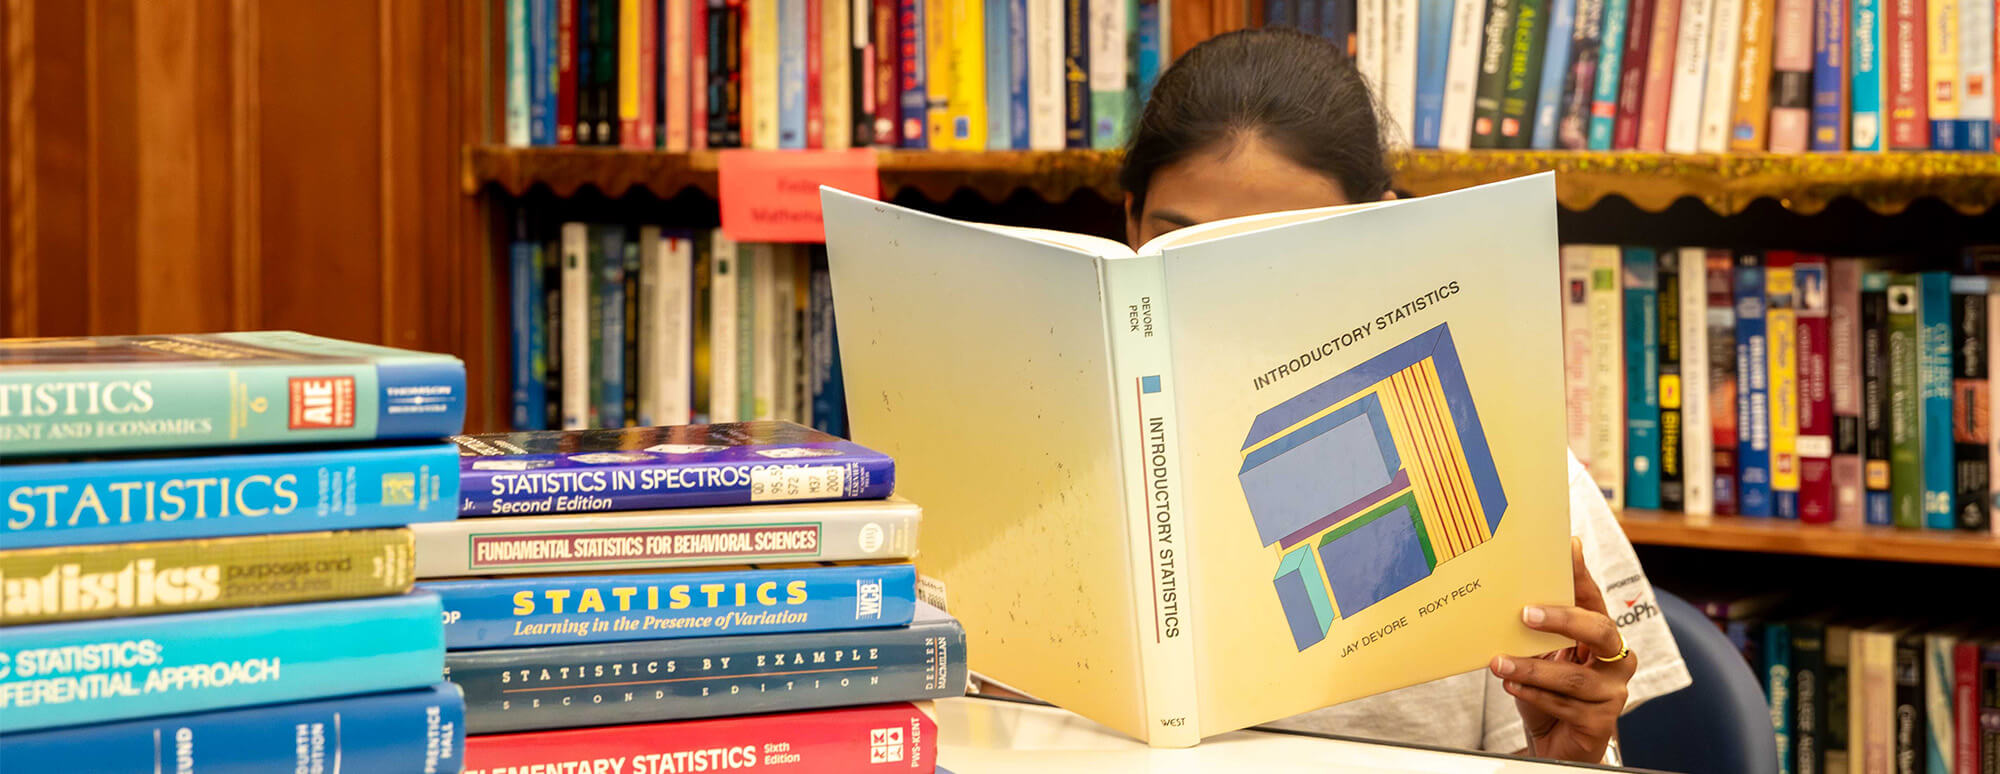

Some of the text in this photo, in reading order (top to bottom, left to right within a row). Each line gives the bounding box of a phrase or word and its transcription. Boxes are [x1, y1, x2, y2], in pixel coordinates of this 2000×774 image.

[1129, 304, 1140, 332] PECK
[1141, 296, 1153, 338] DEVORE
[1253, 280, 1461, 391] INTRODUCTORY STATISTICS
[250, 396, 268, 414] 6
[303, 379, 333, 425] AIE
[47, 422, 92, 440] AND
[96, 417, 213, 438] ECONOMICS
[491, 463, 810, 496] STATISTICS IN SPECTROS
[826, 468, 839, 492] 2003
[851, 462, 860, 498] ELSEVIER
[7, 474, 298, 531] STATISTICS
[462, 495, 612, 514] Jr. Second Edition
[477, 528, 818, 562] FUNDAMENTAL STATISTICS FOR BEHAVIORAL SCIENCES
[1149, 416, 1180, 638] INTRODUCTORY STATISTICS
[226, 560, 310, 581] purposes
[316, 555, 352, 573] and
[512, 580, 809, 616] STATISTICS
[859, 582, 880, 617] WCB
[513, 610, 809, 638] Learning in the Presence of Variation
[1340, 578, 1482, 658] JAY DEVORE ROXY PECK
[15, 639, 164, 678] STATISTICS:
[144, 656, 280, 693] APPROACH
[502, 647, 878, 684] STATISTICS BY EXAMPLE
[925, 637, 934, 691] DELLEN
[937, 636, 948, 690] MACMILLAN
[502, 675, 879, 712] SECOND EDITION
[424, 706, 440, 774] PRENTICE
[440, 722, 453, 759] HALL
[1160, 718, 1186, 727] WEST
[631, 745, 757, 774] STATISTICS
[764, 741, 790, 754] Sixth
[765, 753, 800, 765] Edition
[911, 717, 921, 768] PWS-KENT
